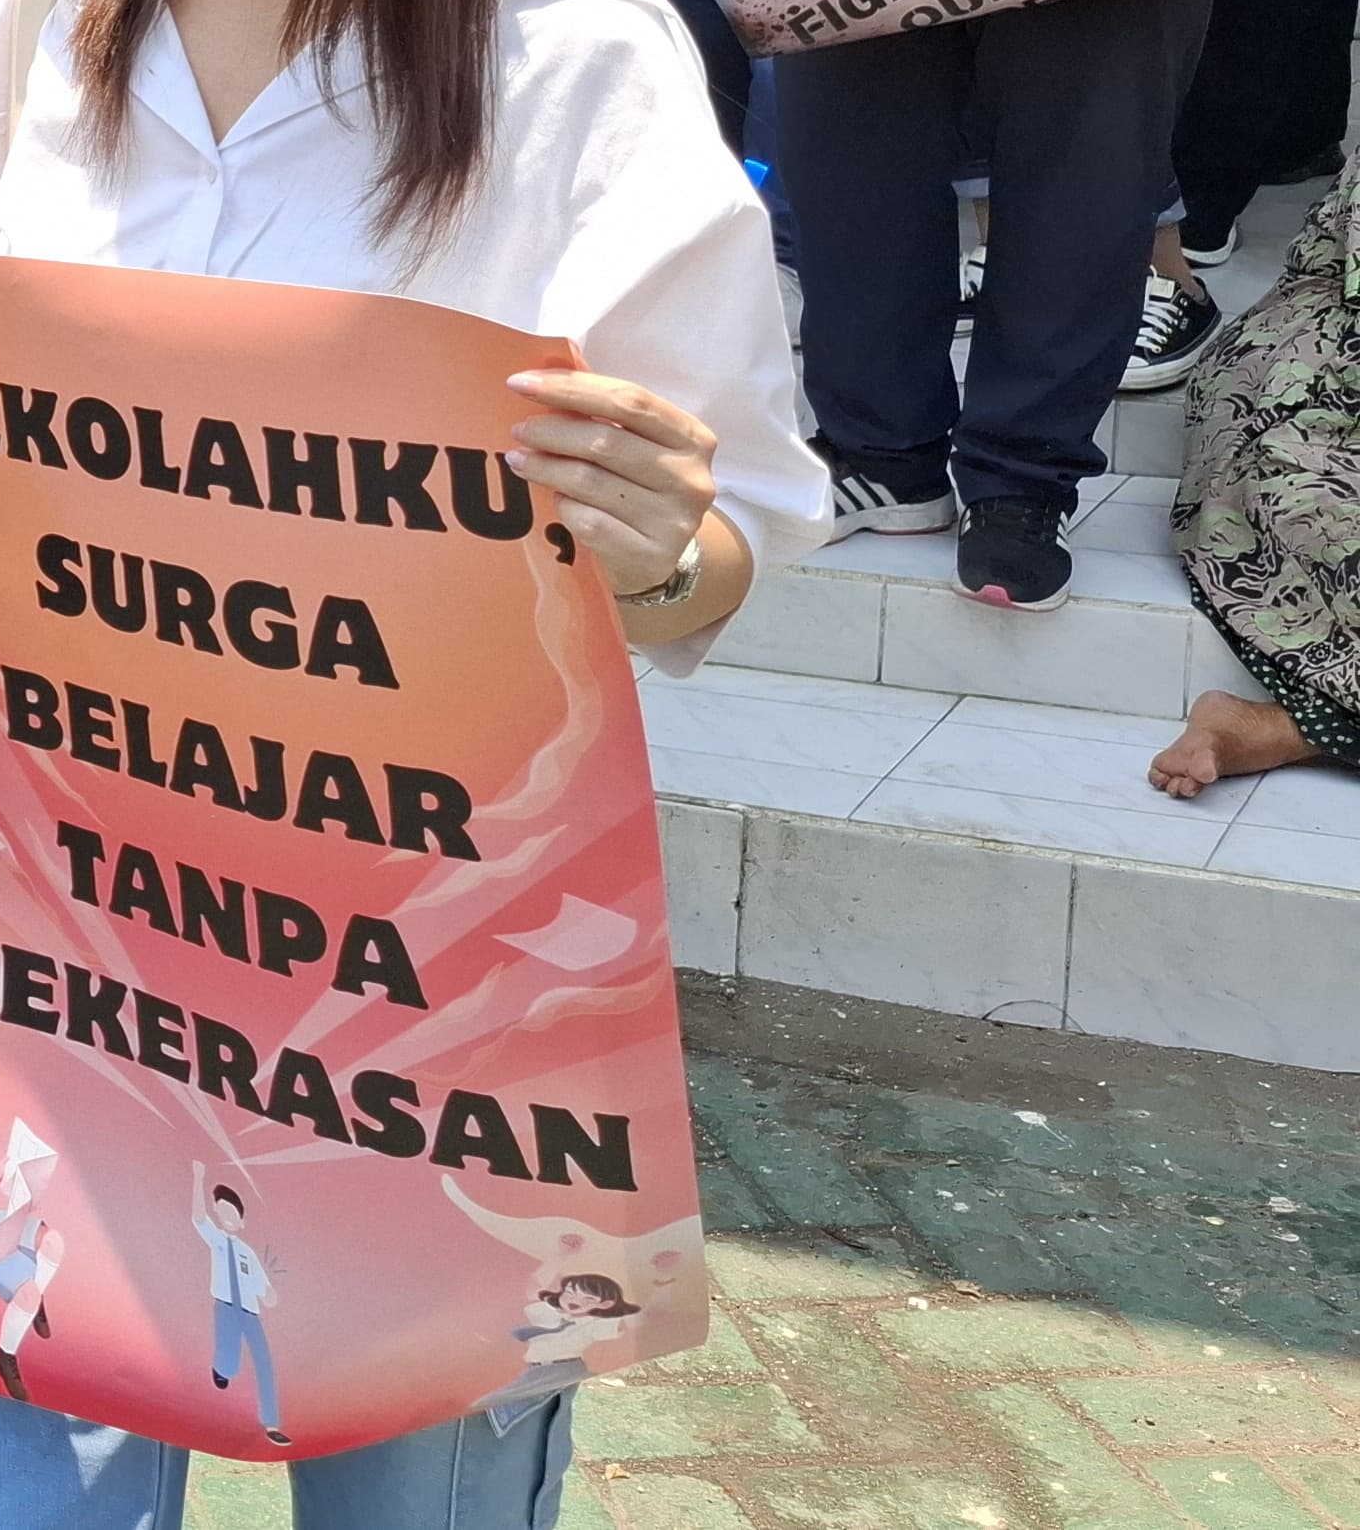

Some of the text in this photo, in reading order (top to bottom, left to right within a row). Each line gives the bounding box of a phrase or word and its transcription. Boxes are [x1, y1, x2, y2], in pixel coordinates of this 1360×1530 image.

[35, 533, 401, 691] SURGA
[0, 664, 483, 863] BELAJAR
[55, 821, 429, 1012] TANPA
